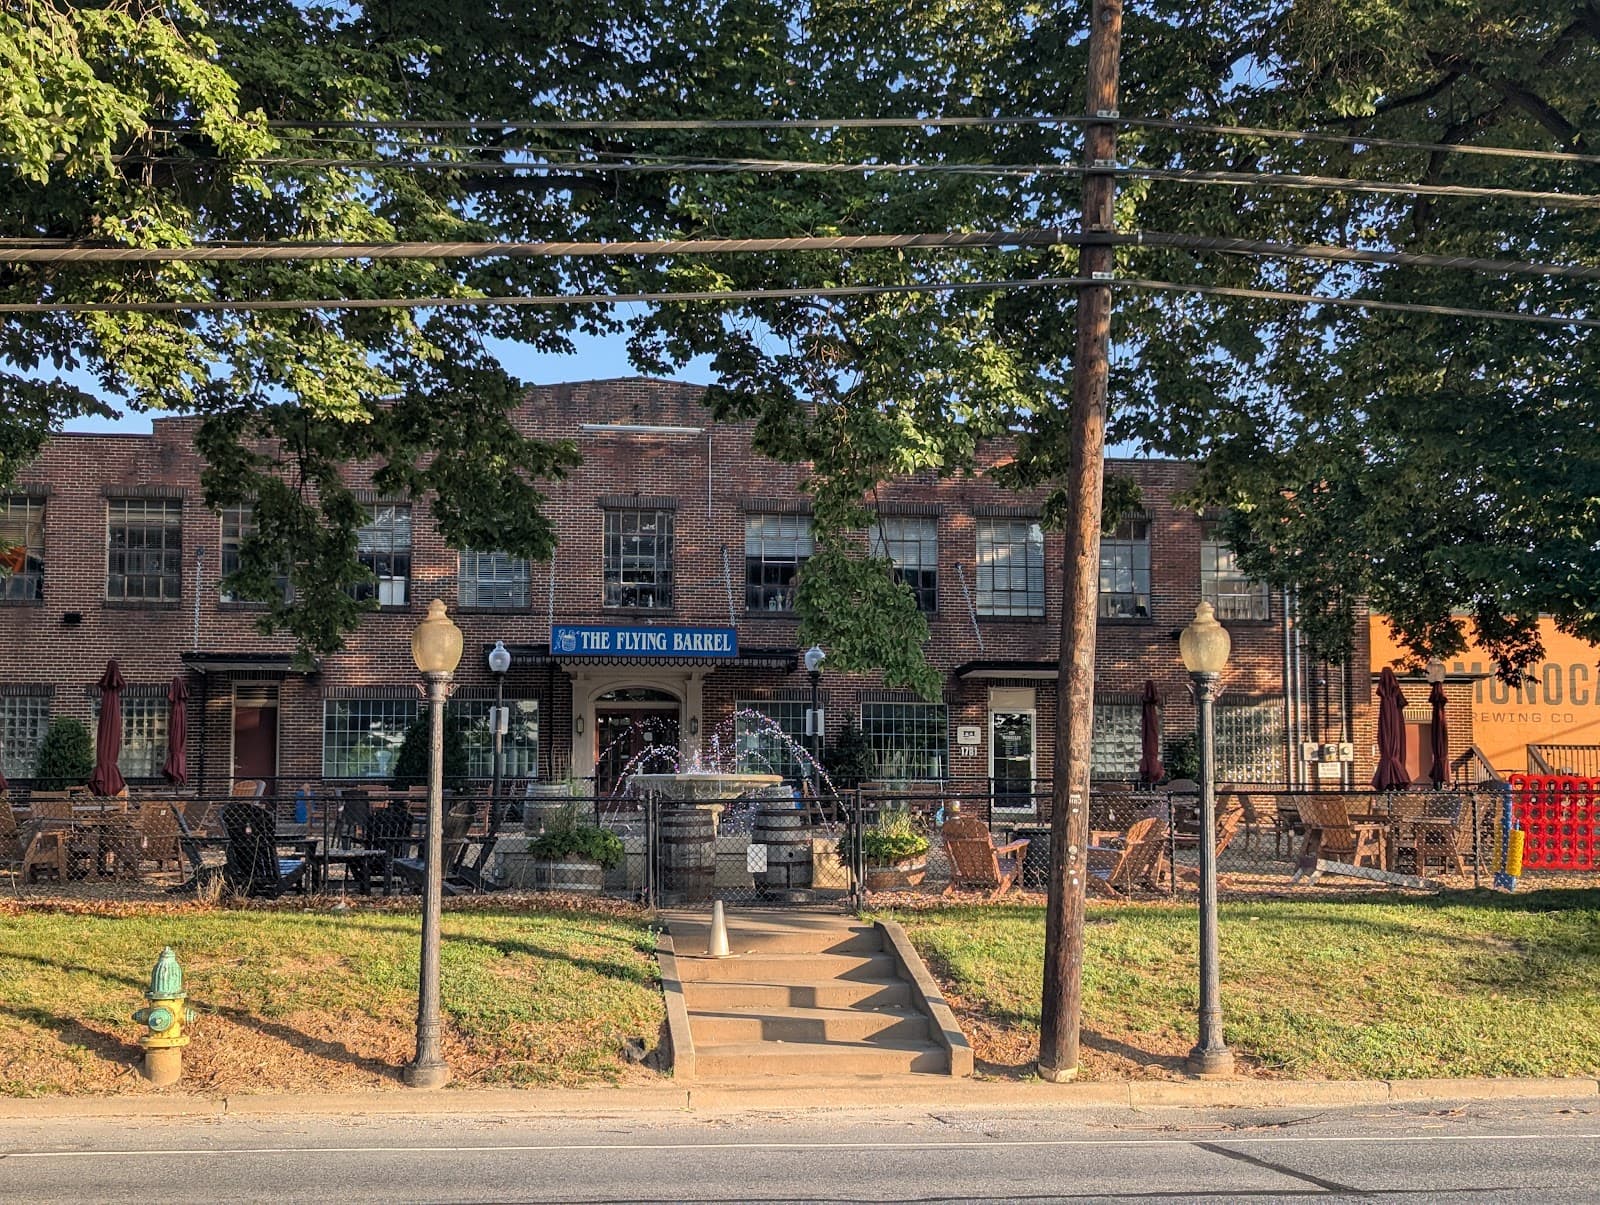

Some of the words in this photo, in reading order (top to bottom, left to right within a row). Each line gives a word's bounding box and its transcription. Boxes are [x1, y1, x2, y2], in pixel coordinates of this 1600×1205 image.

[580, 631, 611, 650] THE
[616, 632, 668, 651] FLYING
[672, 633, 732, 652] BARREL
[1453, 661, 1600, 706] MONOC
[1472, 711, 1542, 723] REWING
[960, 746, 978, 757] 1781
